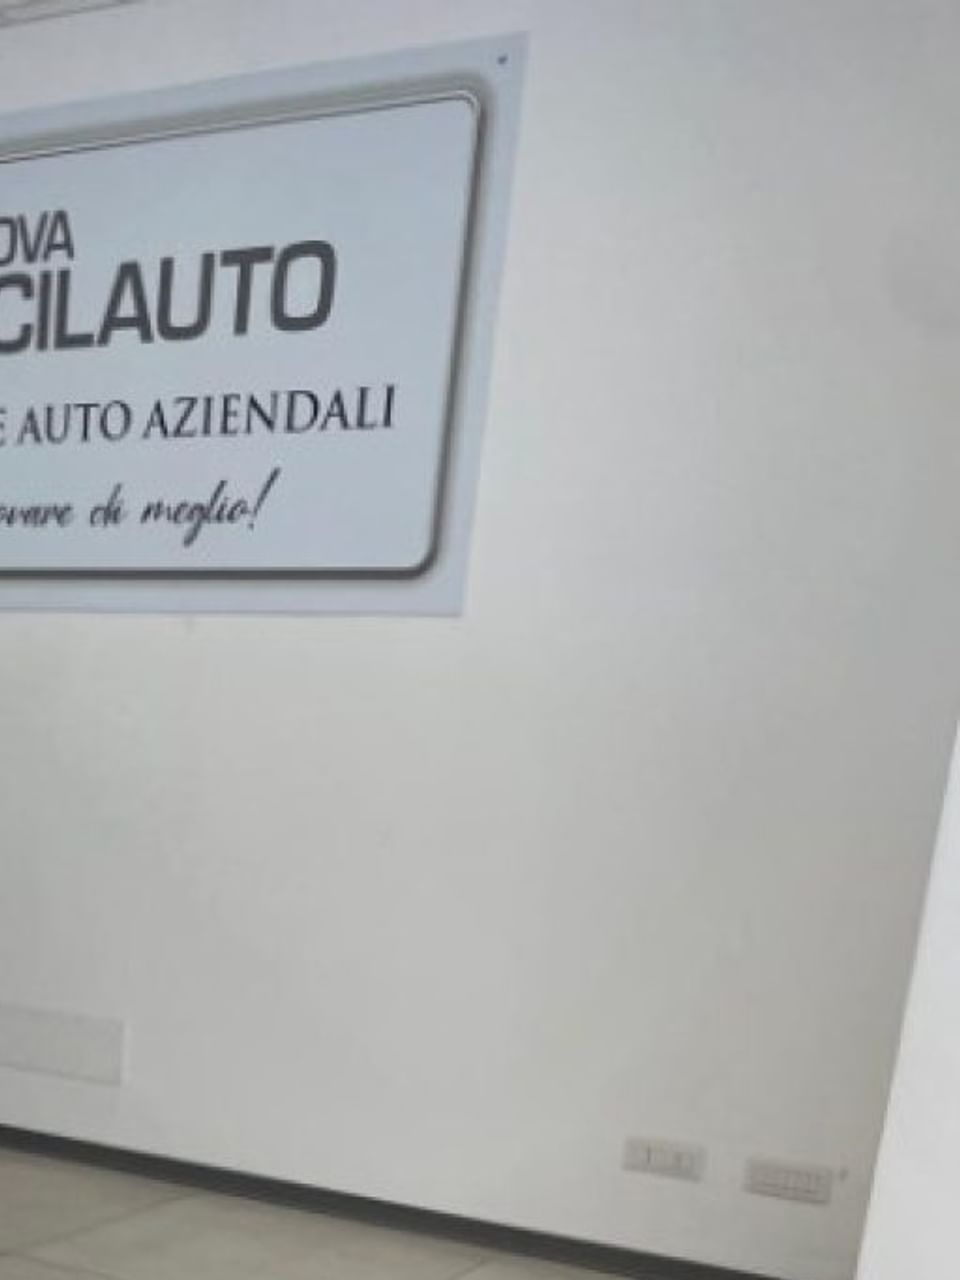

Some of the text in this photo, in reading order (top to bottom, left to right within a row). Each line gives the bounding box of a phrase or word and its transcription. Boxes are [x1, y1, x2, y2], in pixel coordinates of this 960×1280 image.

[16, 399, 134, 445] AUTO
[142, 384, 396, 439] AZIENDALI
[88, 482, 126, 528] di
[139, 466, 281, 547] meglio!
